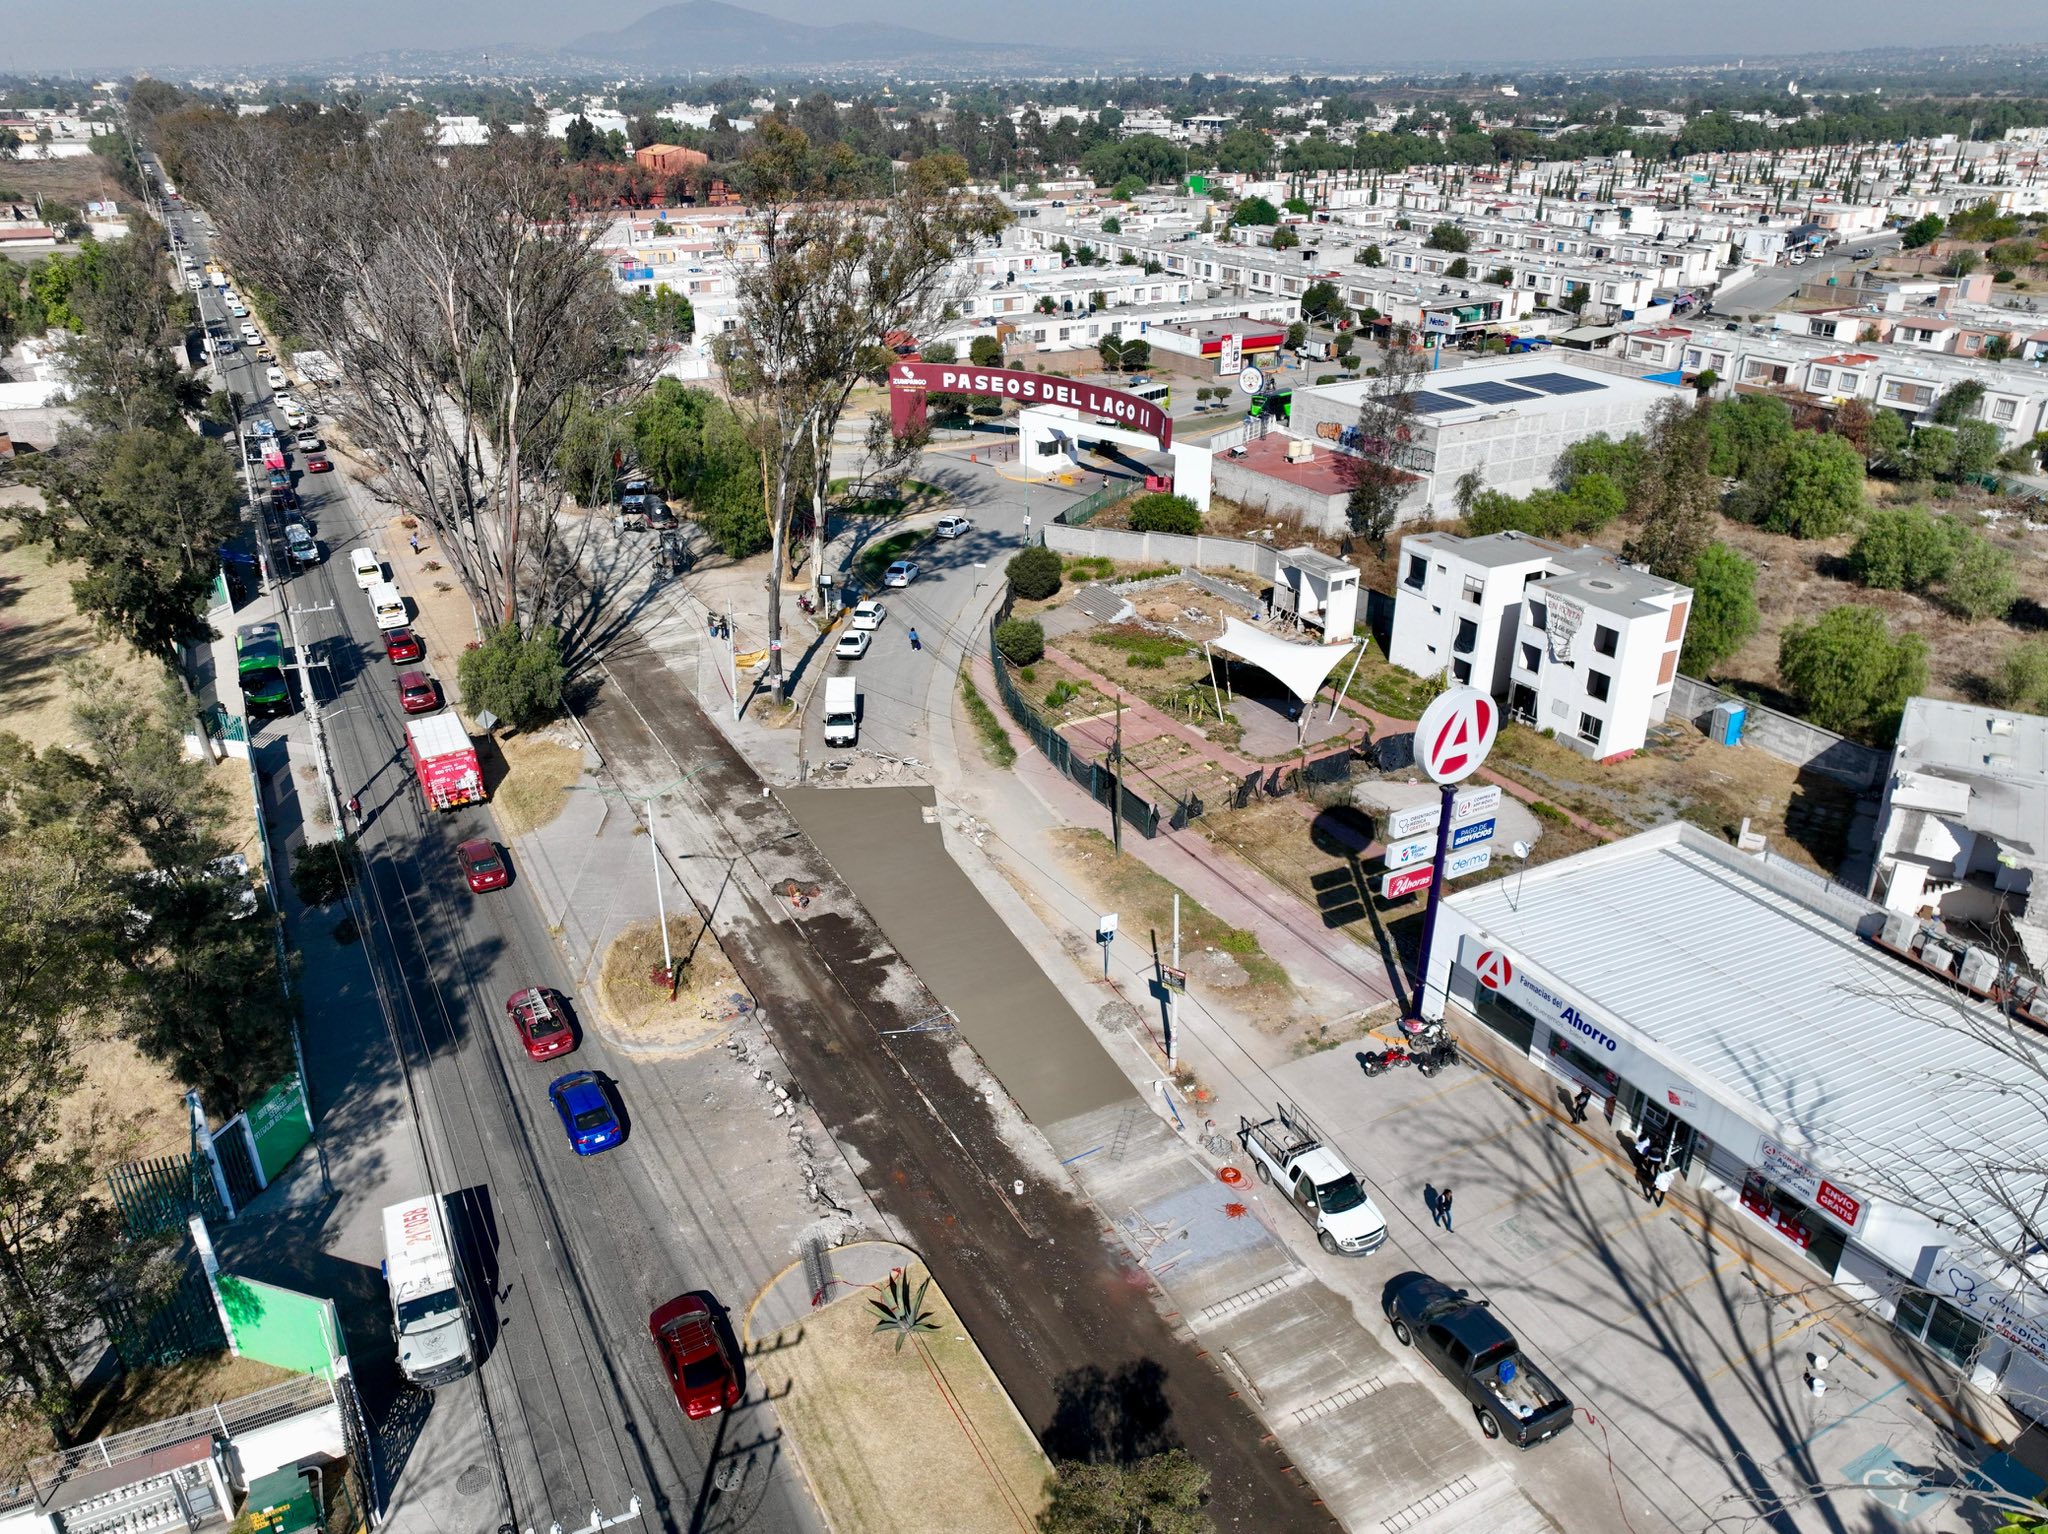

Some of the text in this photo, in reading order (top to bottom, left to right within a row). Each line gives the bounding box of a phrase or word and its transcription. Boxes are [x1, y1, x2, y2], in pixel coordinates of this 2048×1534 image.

[1429, 317, 1444, 327] Neto
[893, 378, 927, 386] ZUMPANGO
[943, 372, 1150, 427] PASEOS DEL LAGO II
[1548, 600, 1557, 609] EN
[1454, 827, 1493, 846] SERVICIOS
[1460, 822, 1488, 837] PAGO DE
[1452, 853, 1488, 871] derma
[1520, 975, 1617, 1051] Farmacias del Ahorro
[1777, 1157, 1792, 1171] App
[1825, 1187, 1854, 1210] ENVÍO
[1820, 1195, 1853, 1221] GRATIS
